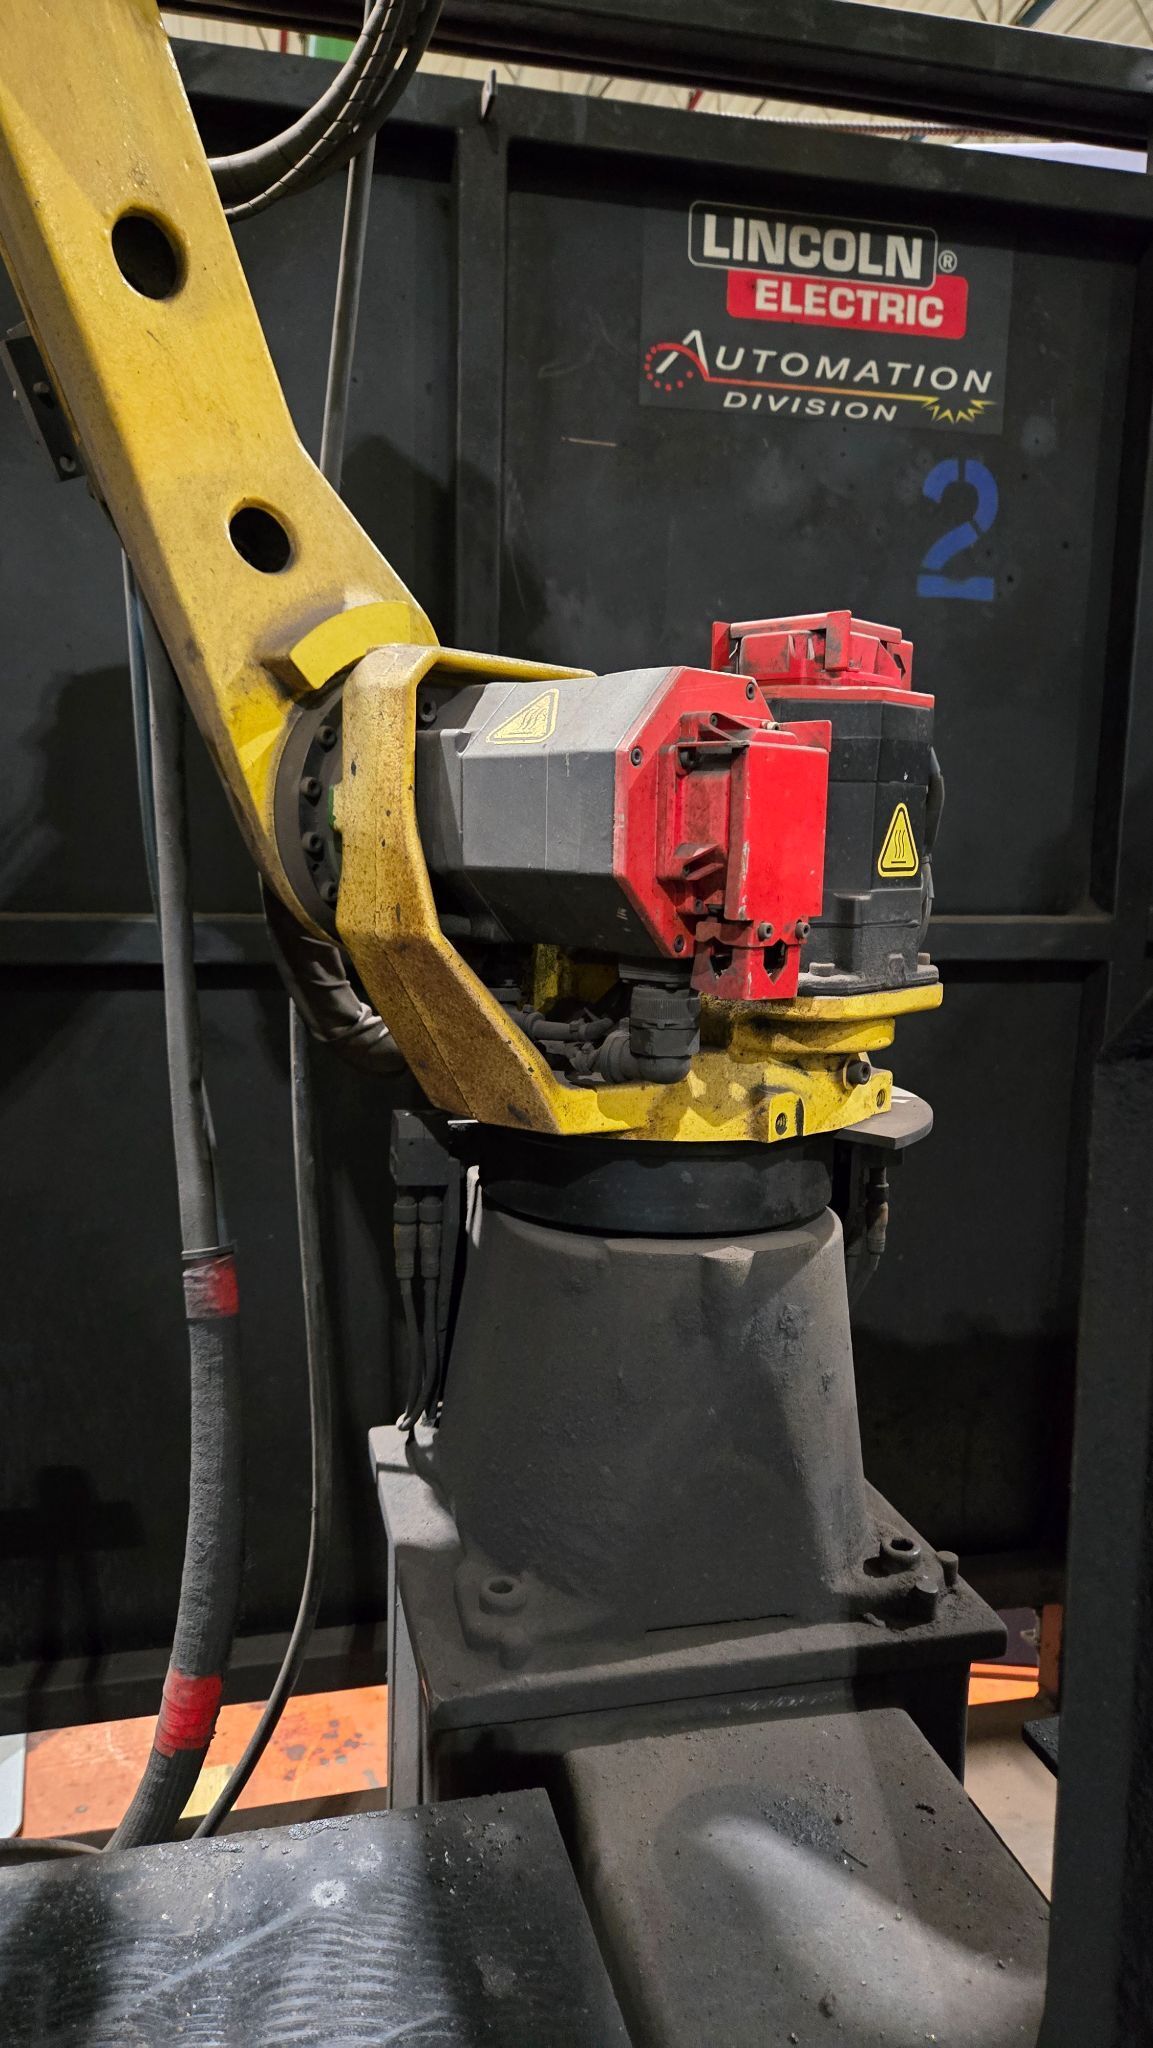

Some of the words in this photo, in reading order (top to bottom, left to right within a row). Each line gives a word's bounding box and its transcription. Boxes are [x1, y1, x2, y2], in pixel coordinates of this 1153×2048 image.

[703, 213, 922, 280] LINCOLN
[755, 278, 944, 328] ELECTRIC
[656, 330, 992, 394] AUTOMATION
[723, 391, 898, 421] DIVISION
[917, 459, 999, 600] 2
